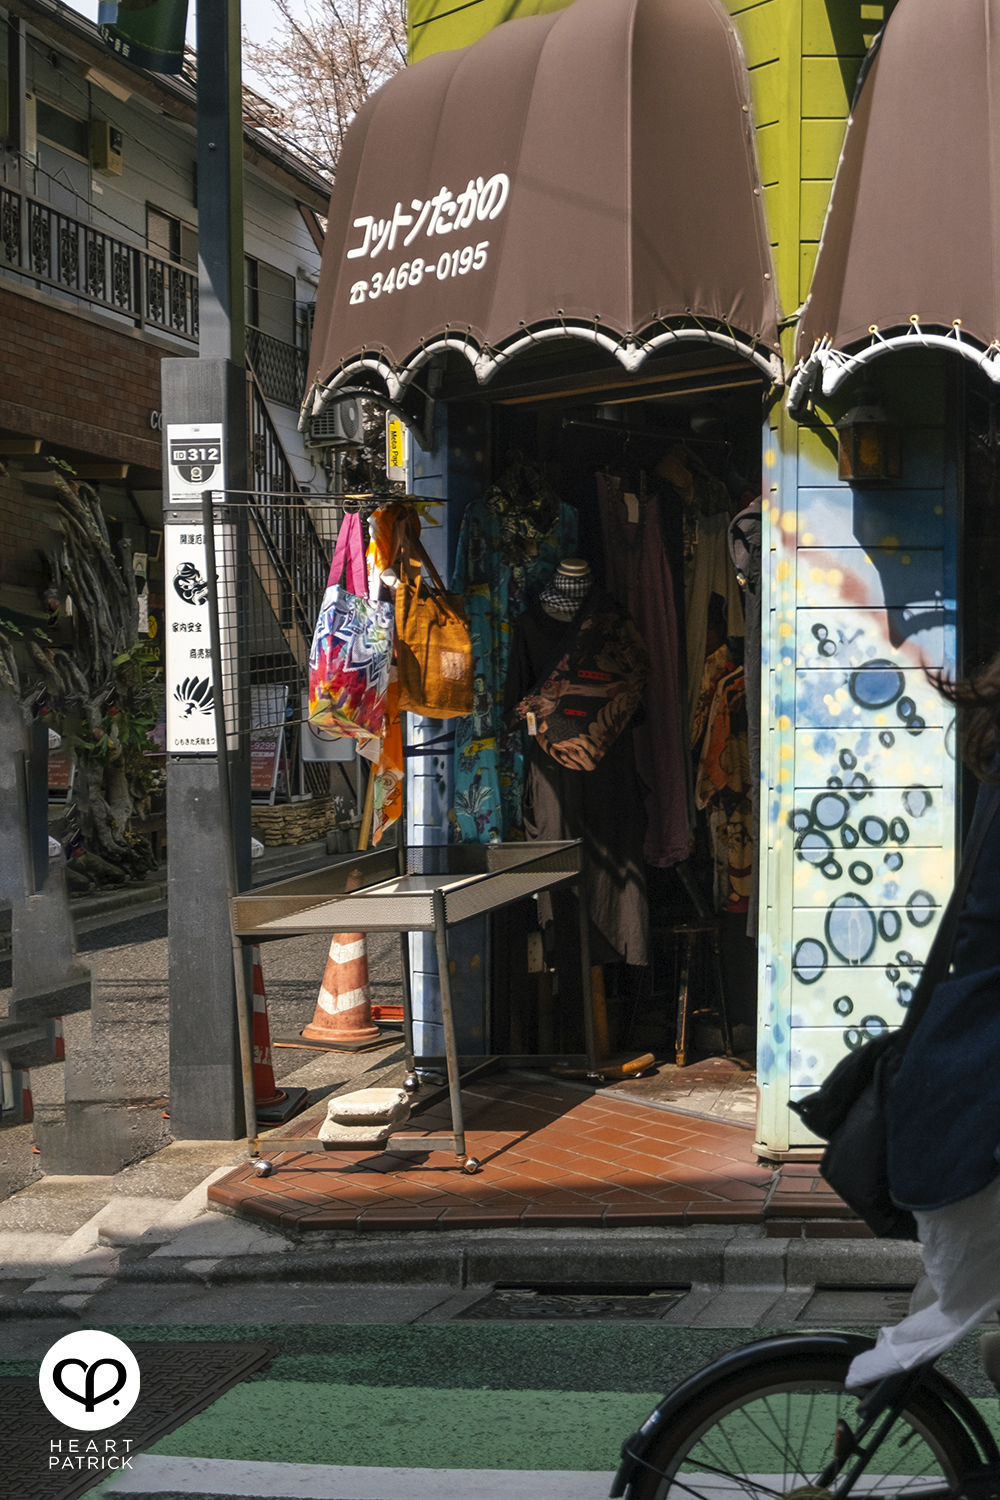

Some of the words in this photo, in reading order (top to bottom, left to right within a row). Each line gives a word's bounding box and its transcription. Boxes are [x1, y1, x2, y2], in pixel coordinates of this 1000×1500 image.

[368, 241, 489, 299] 3468-0195
[187, 448, 219, 461] 312
[179, 533, 206, 545] 開運厄
[172, 622, 202, 633] 家内安全
[189, 648, 212, 659] 商売繁
[174, 738, 216, 746] しもきた天狗まつ
